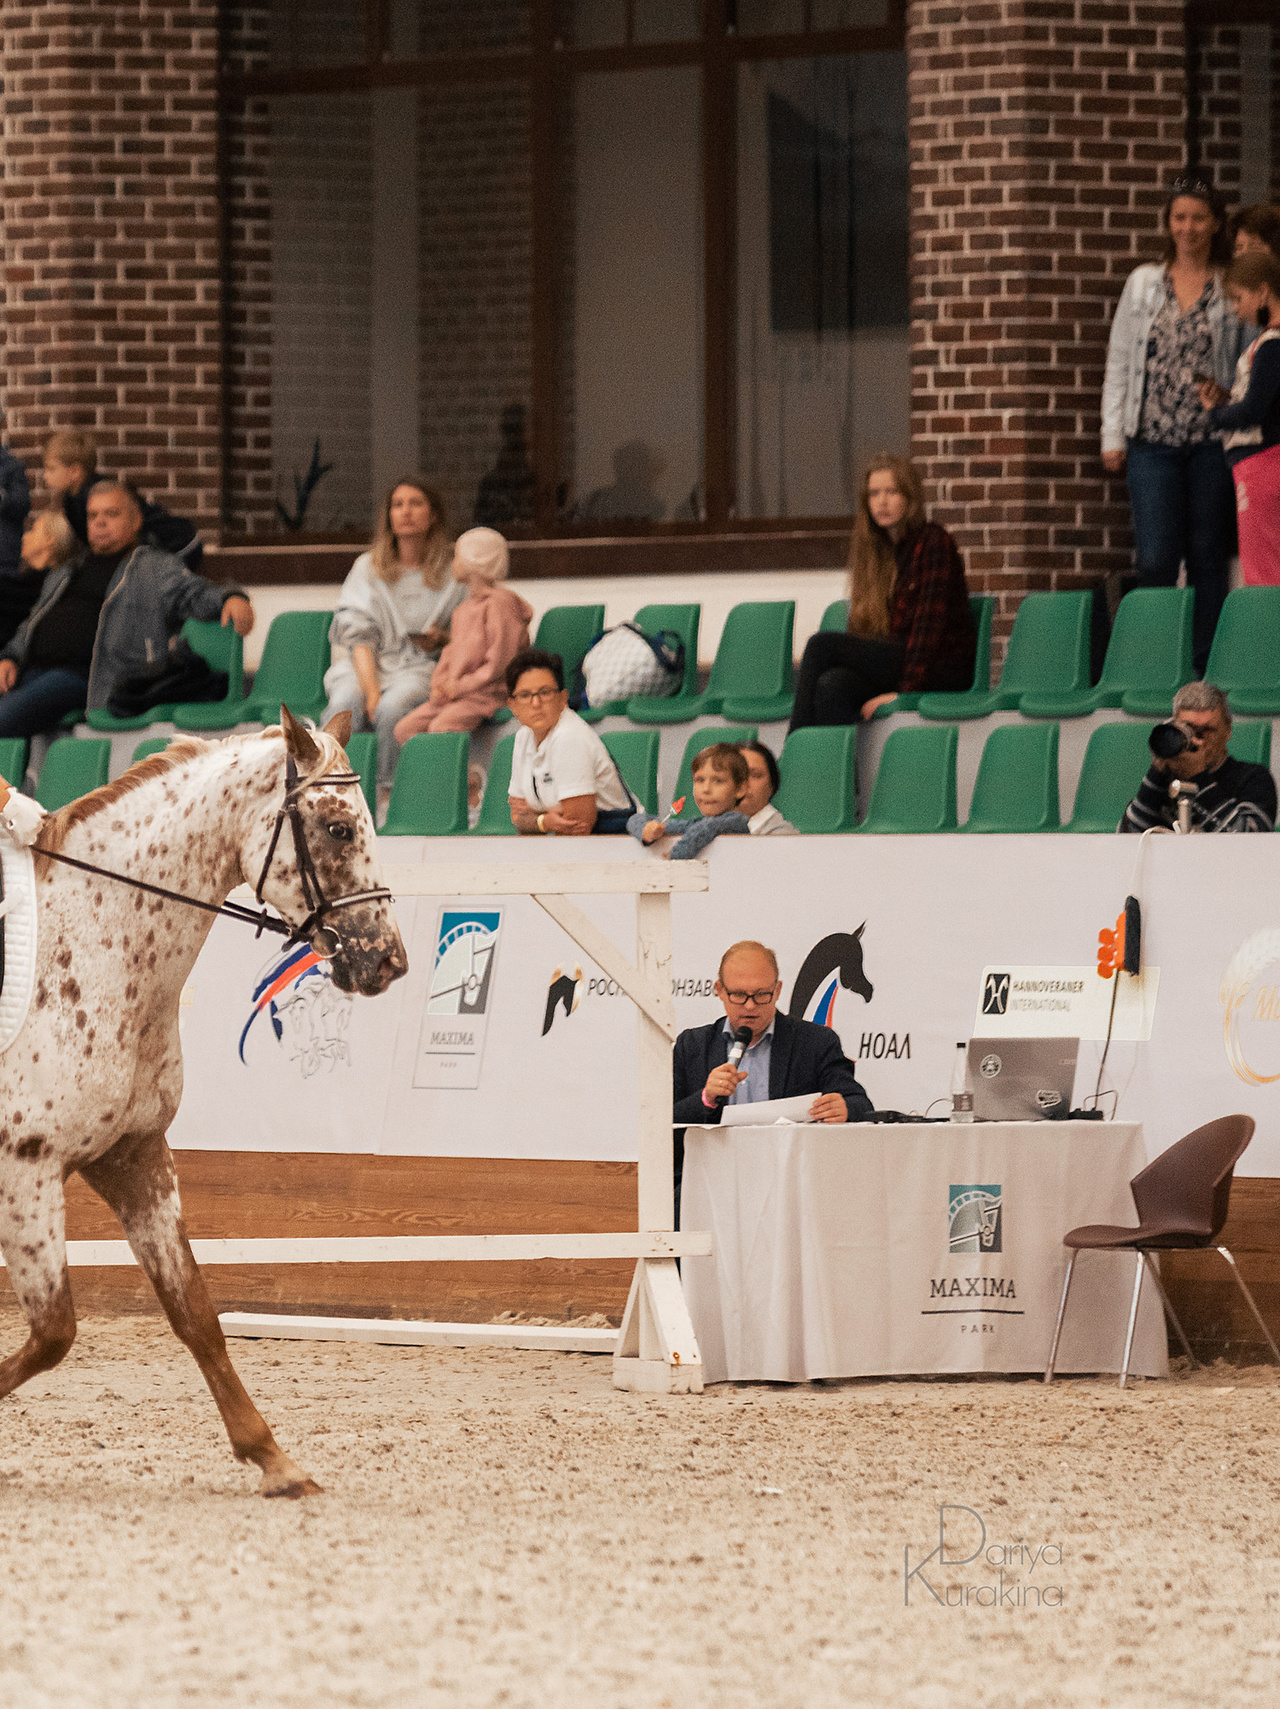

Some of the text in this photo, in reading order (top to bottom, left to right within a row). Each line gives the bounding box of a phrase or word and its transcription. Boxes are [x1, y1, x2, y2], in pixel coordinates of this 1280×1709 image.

[430, 1032, 474, 1045] MAXIMA
[858, 1032, 911, 1059] НОАЛ
[930, 1277, 1017, 1298] MAXIMA
[961, 1324, 995, 1333] PARK
